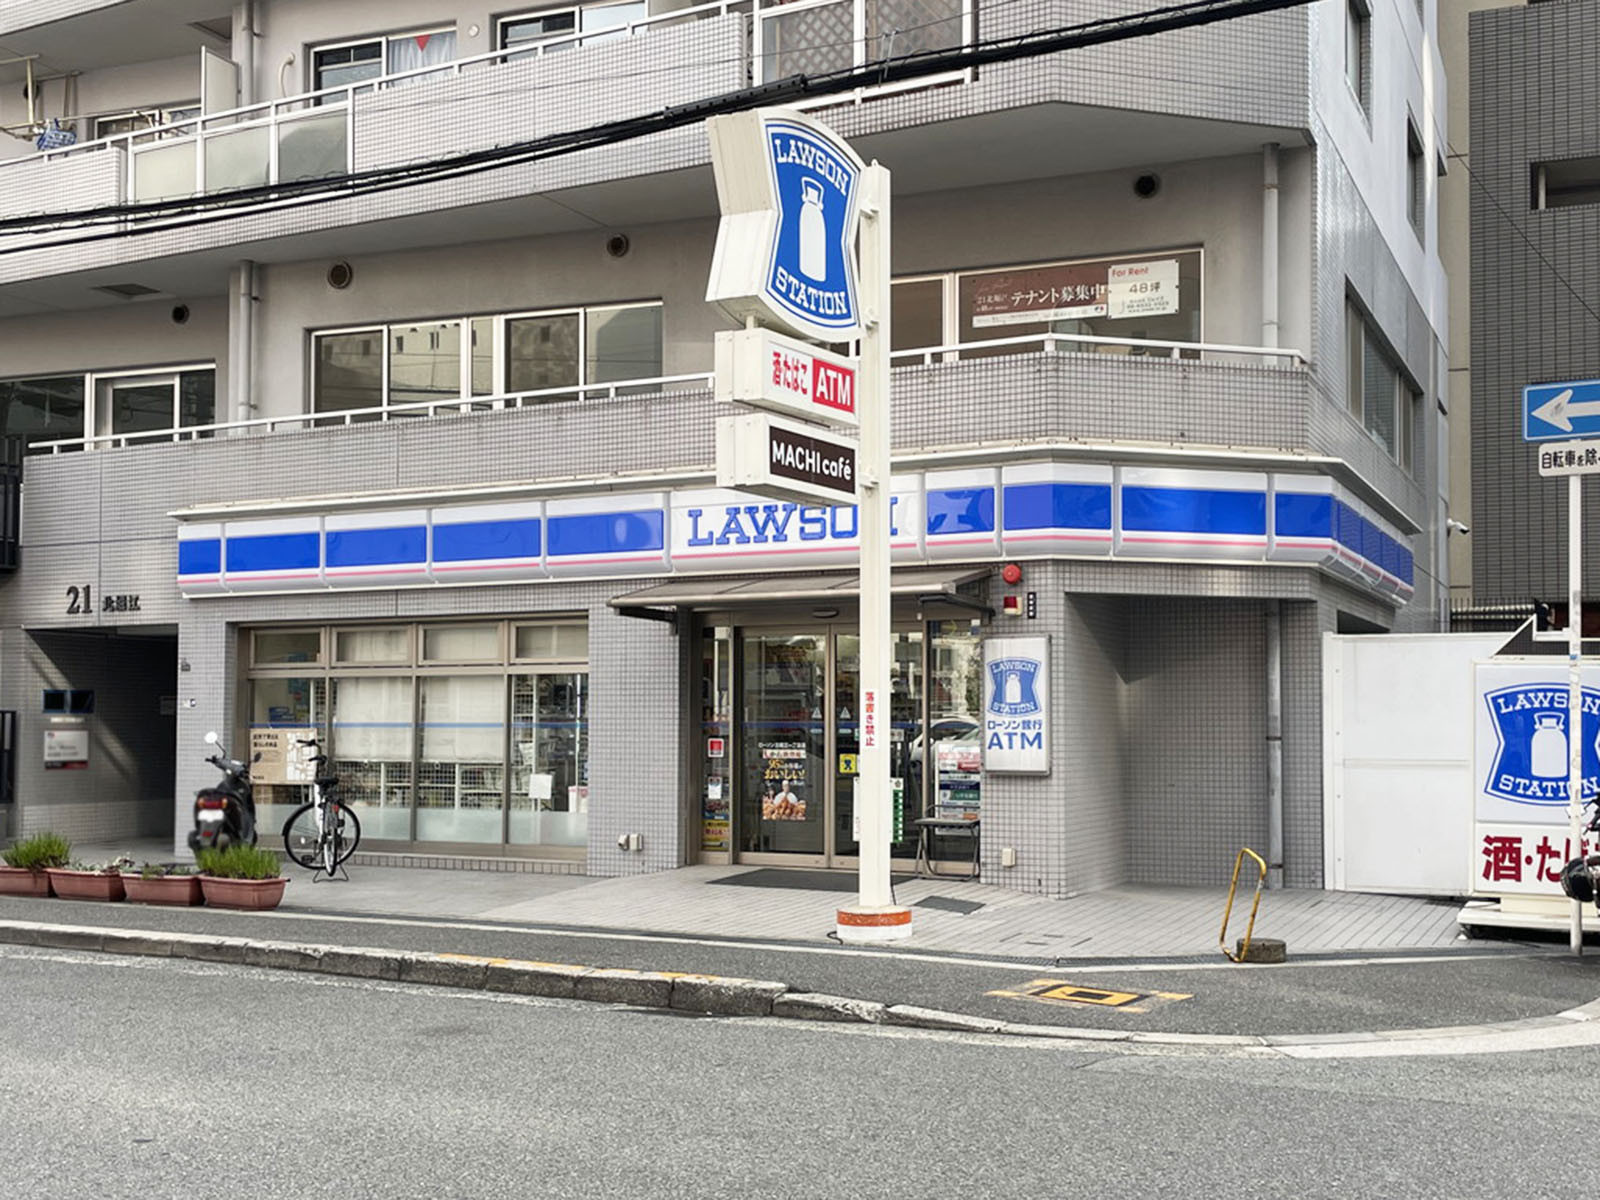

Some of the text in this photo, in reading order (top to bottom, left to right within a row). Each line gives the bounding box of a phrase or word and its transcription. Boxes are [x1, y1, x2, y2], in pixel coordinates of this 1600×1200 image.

[774, 139, 849, 196] LAWSON
[1112, 265, 1150, 277] For Rent
[775, 266, 848, 315] STATION
[1010, 283, 1107, 307] テナント募集中
[773, 351, 851, 406] 酒たばこ ATM
[772, 440, 852, 481] MACHI café
[1541, 447, 1600, 469] 自転車を除
[688, 496, 898, 547] LAWSO
[67, 585, 93, 614] 21
[992, 661, 1036, 674] LAWSON
[992, 701, 1036, 714] STATION
[1498, 692, 1600, 715] LAWSN
[987, 719, 1042, 730] ローソン銀行
[987, 732, 1042, 750] ATM
[1498, 776, 1599, 798] STATIN
